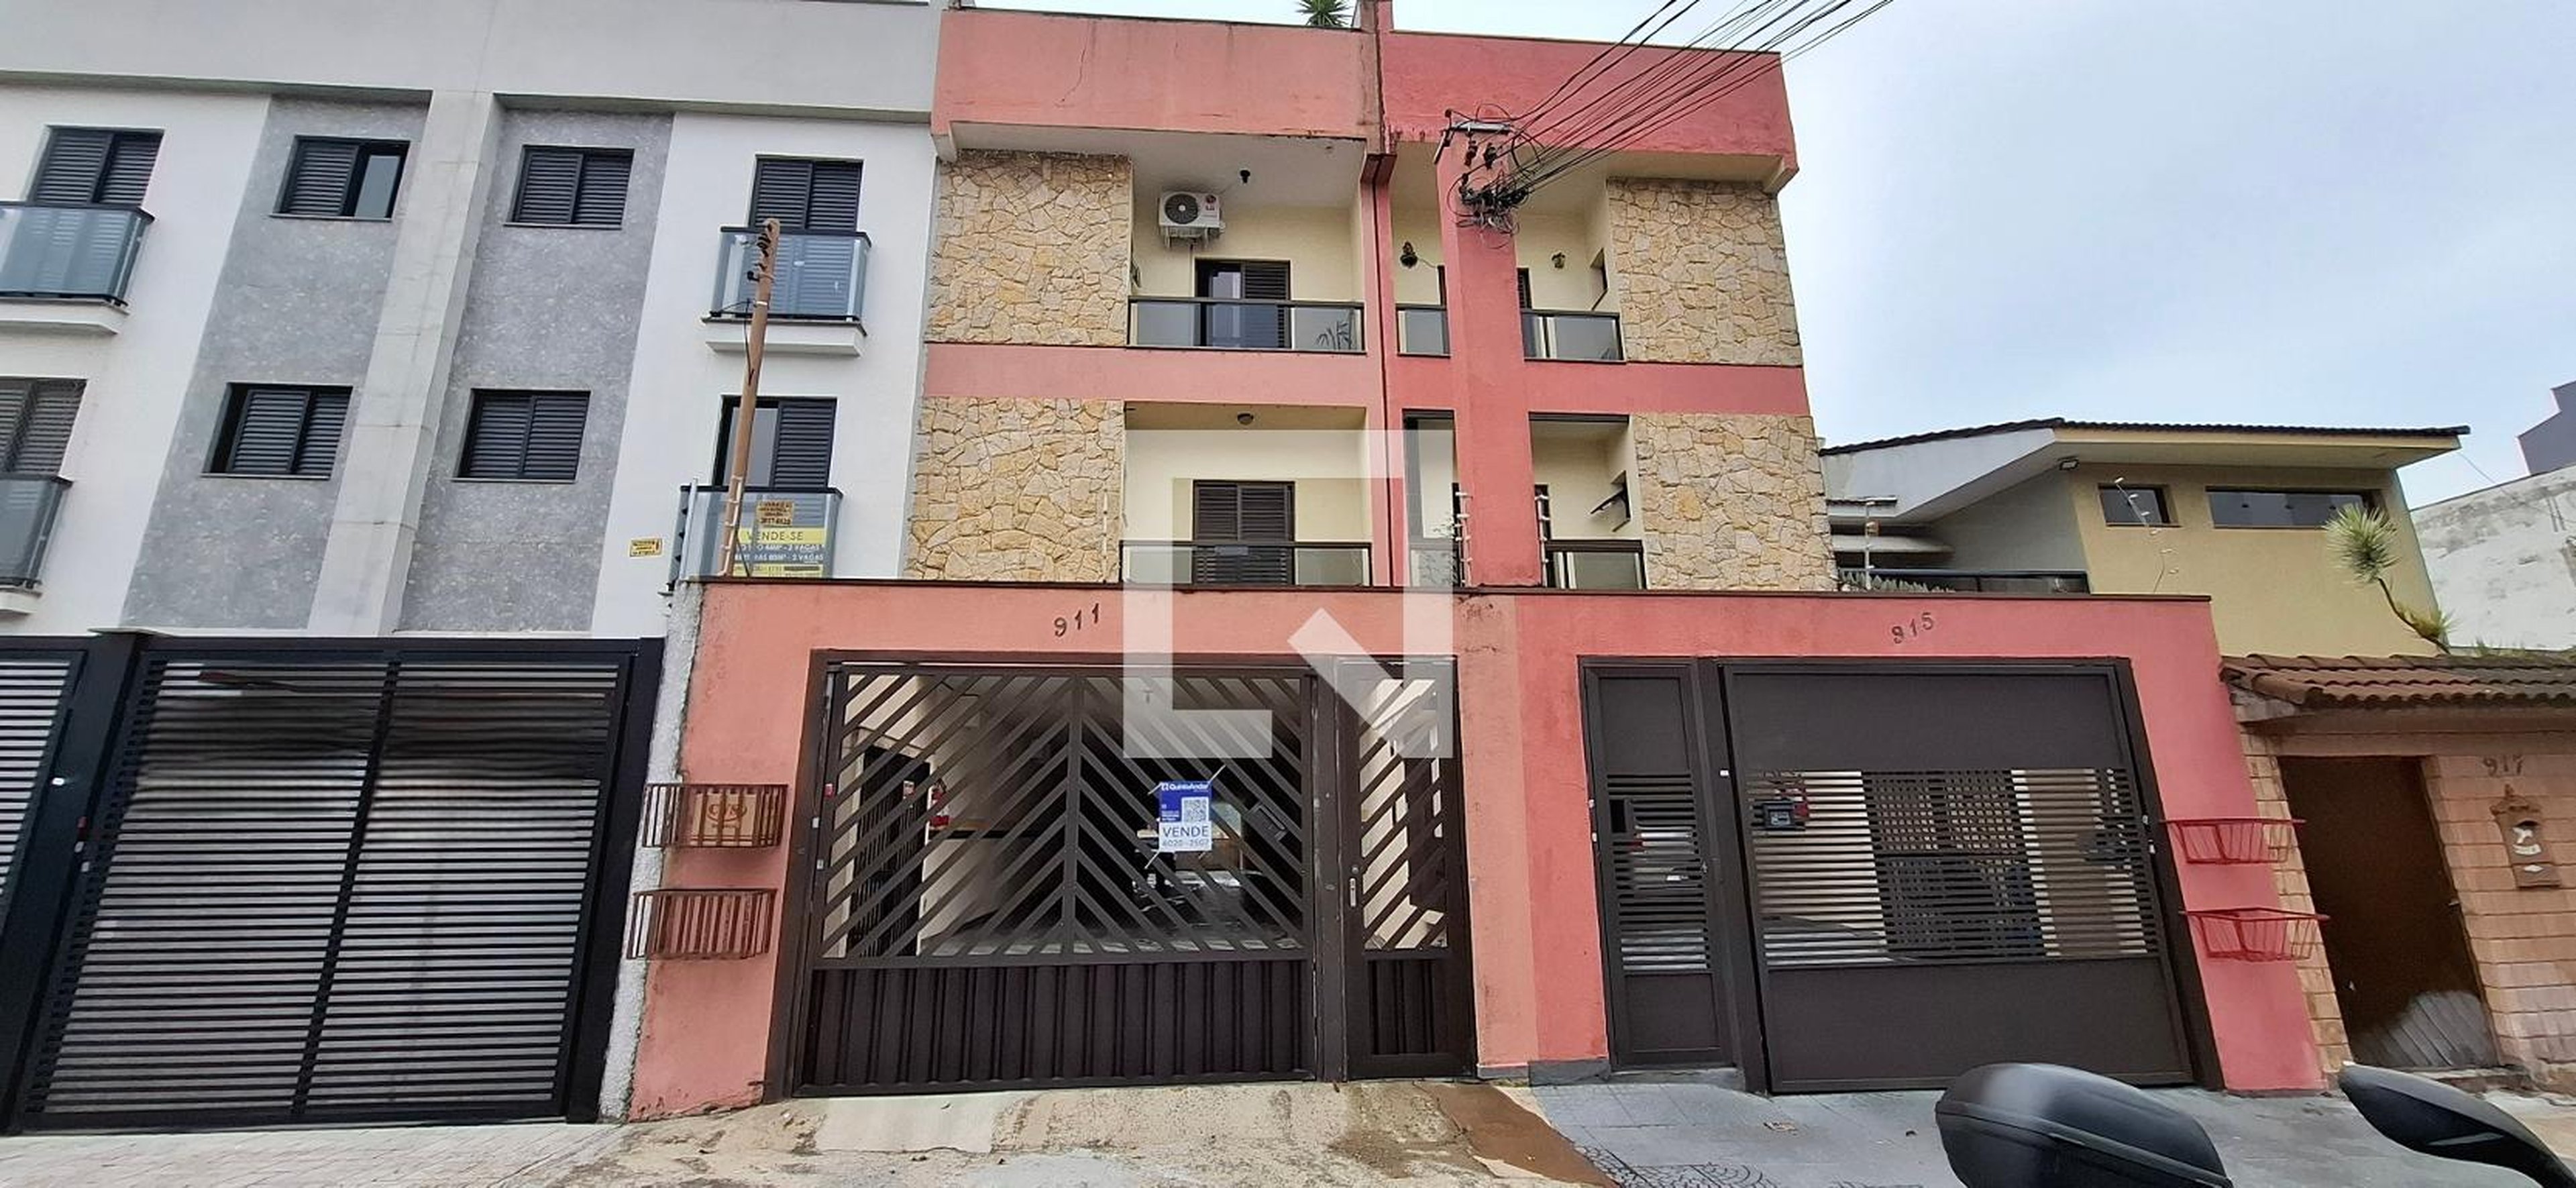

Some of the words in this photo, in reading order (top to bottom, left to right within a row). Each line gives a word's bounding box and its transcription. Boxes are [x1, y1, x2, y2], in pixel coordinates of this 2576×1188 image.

[746, 531, 804, 541] VENDE-SE
[1054, 602, 1099, 637] 911
[1892, 611, 1933, 644] 915
[2483, 755, 2524, 776] 917
[1163, 825, 1209, 838] VENDE
